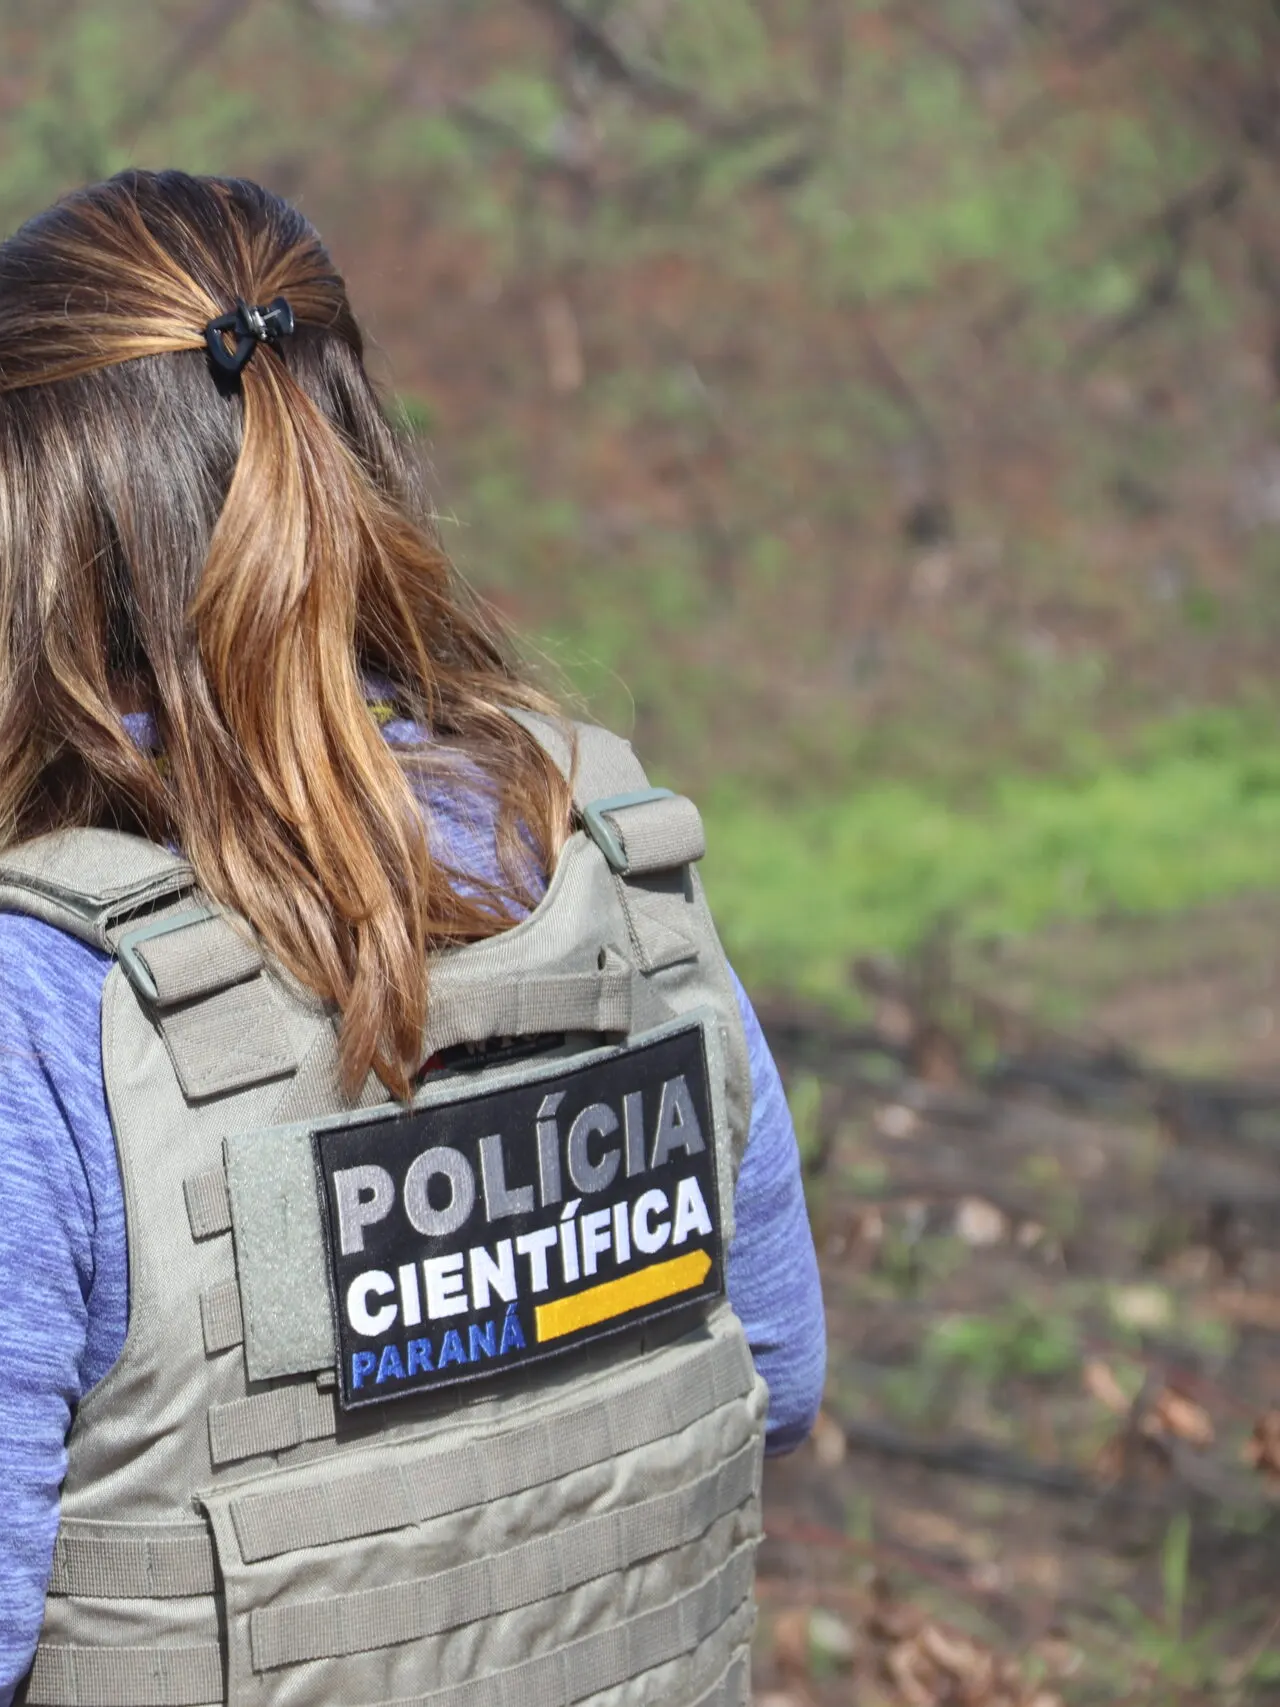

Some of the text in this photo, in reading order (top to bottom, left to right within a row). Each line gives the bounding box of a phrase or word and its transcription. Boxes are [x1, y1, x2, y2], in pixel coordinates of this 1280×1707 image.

[333, 1074, 706, 1255] POLÍCIA
[347, 1176, 712, 1336] CIENTÍFICA
[351, 1303, 526, 1388] PARANÁ
